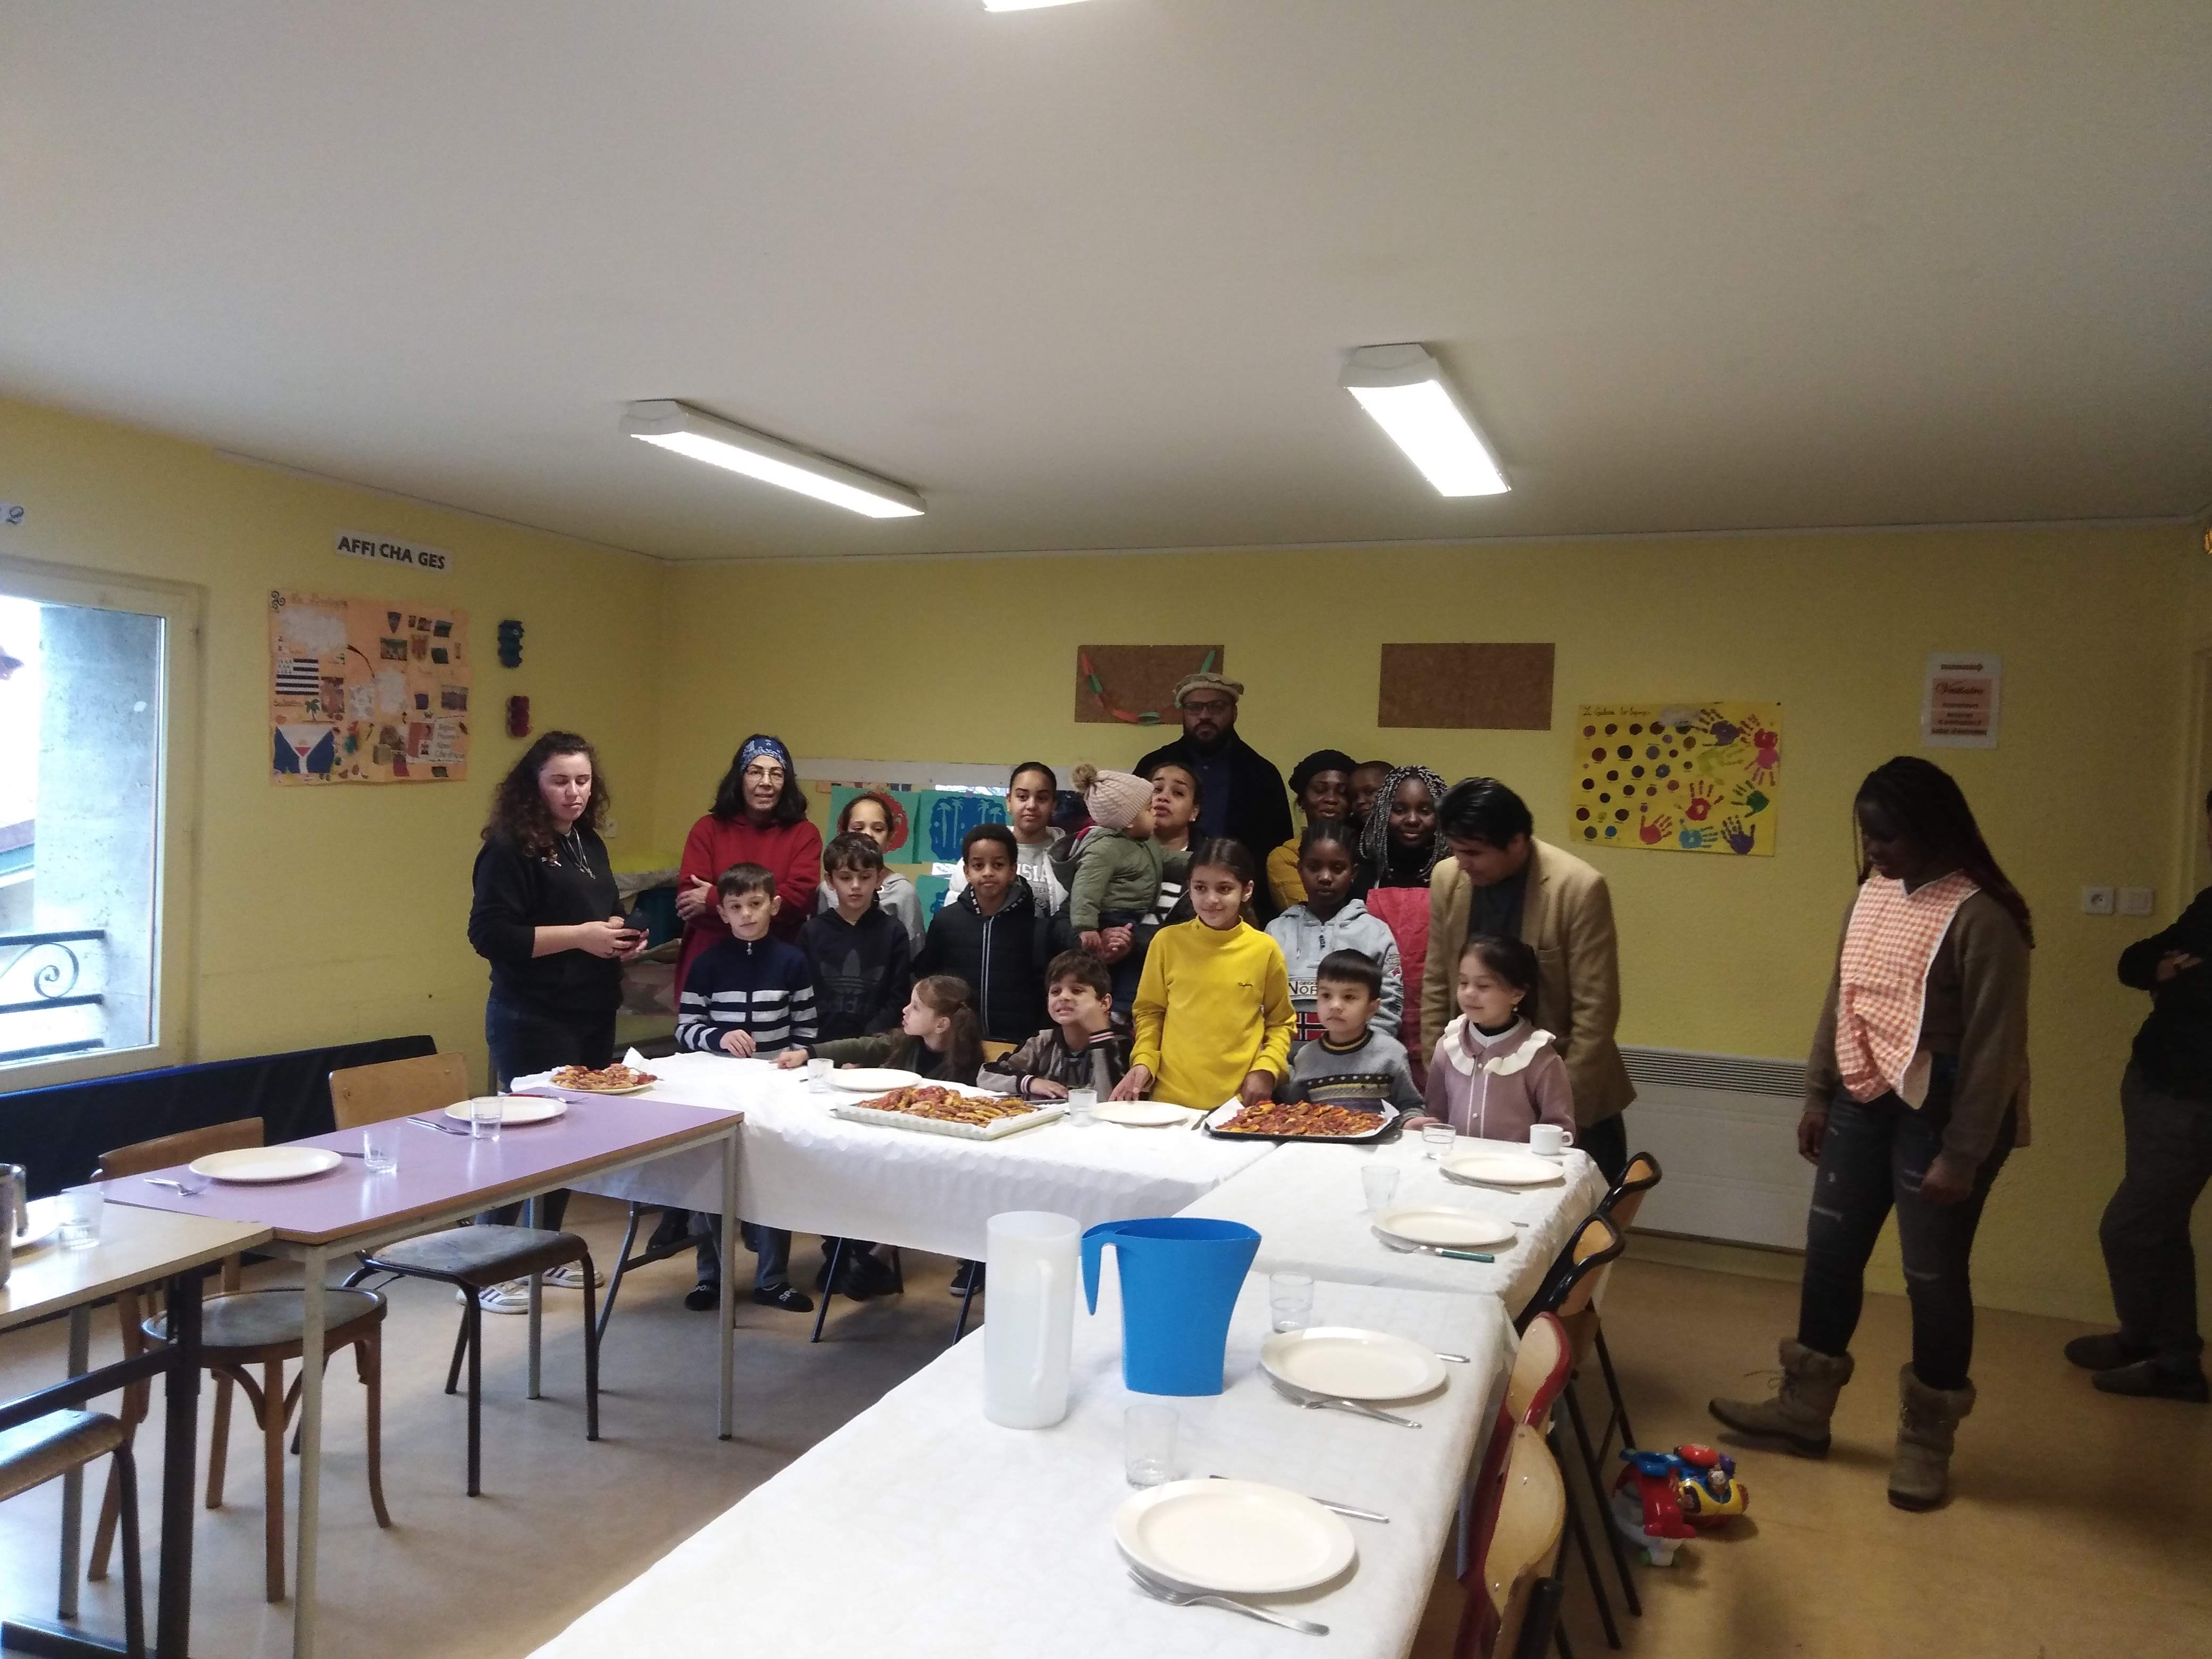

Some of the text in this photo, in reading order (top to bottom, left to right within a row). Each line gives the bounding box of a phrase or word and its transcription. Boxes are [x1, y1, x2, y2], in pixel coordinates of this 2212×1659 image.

[337, 536, 446, 569] AFFI CHA GES
